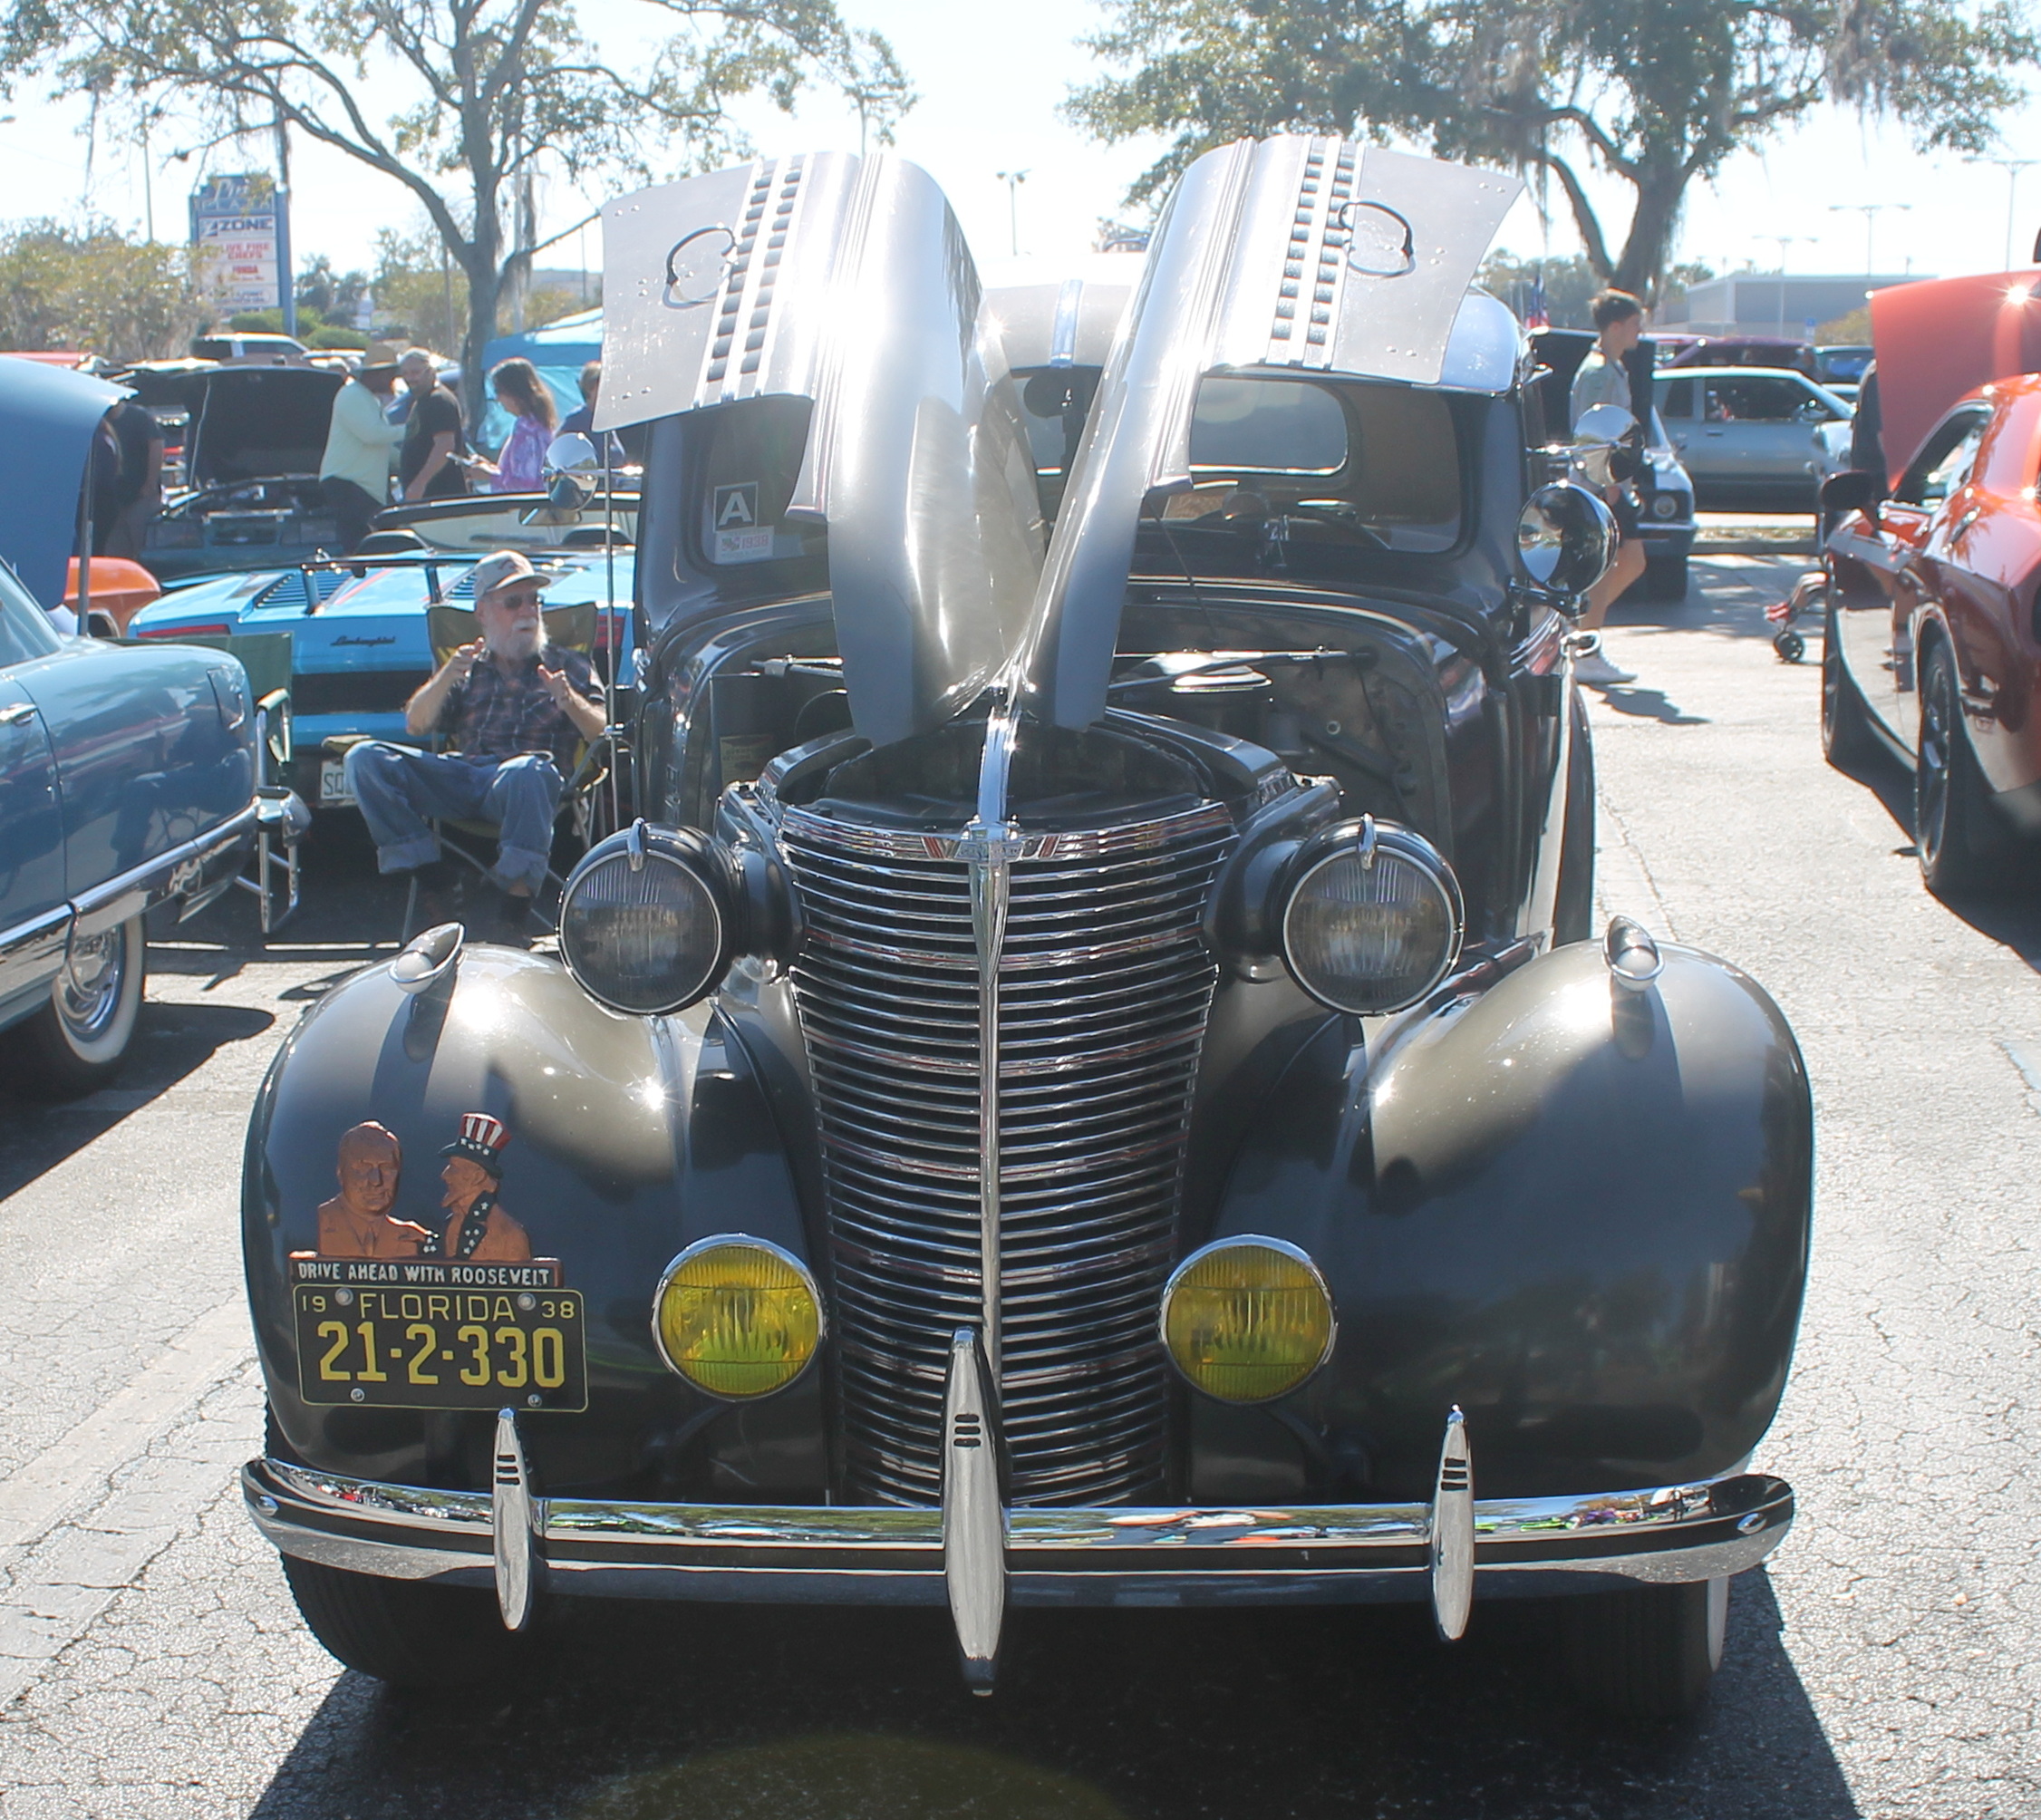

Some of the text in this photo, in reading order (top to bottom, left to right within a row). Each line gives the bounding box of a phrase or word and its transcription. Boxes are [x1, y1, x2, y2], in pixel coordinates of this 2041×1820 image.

[718, 491, 752, 526] A
[297, 1262, 550, 1286] DRIVE AHEAD WITH ROOSEVELT
[302, 1292, 576, 1321] 19 FLORIDA 38
